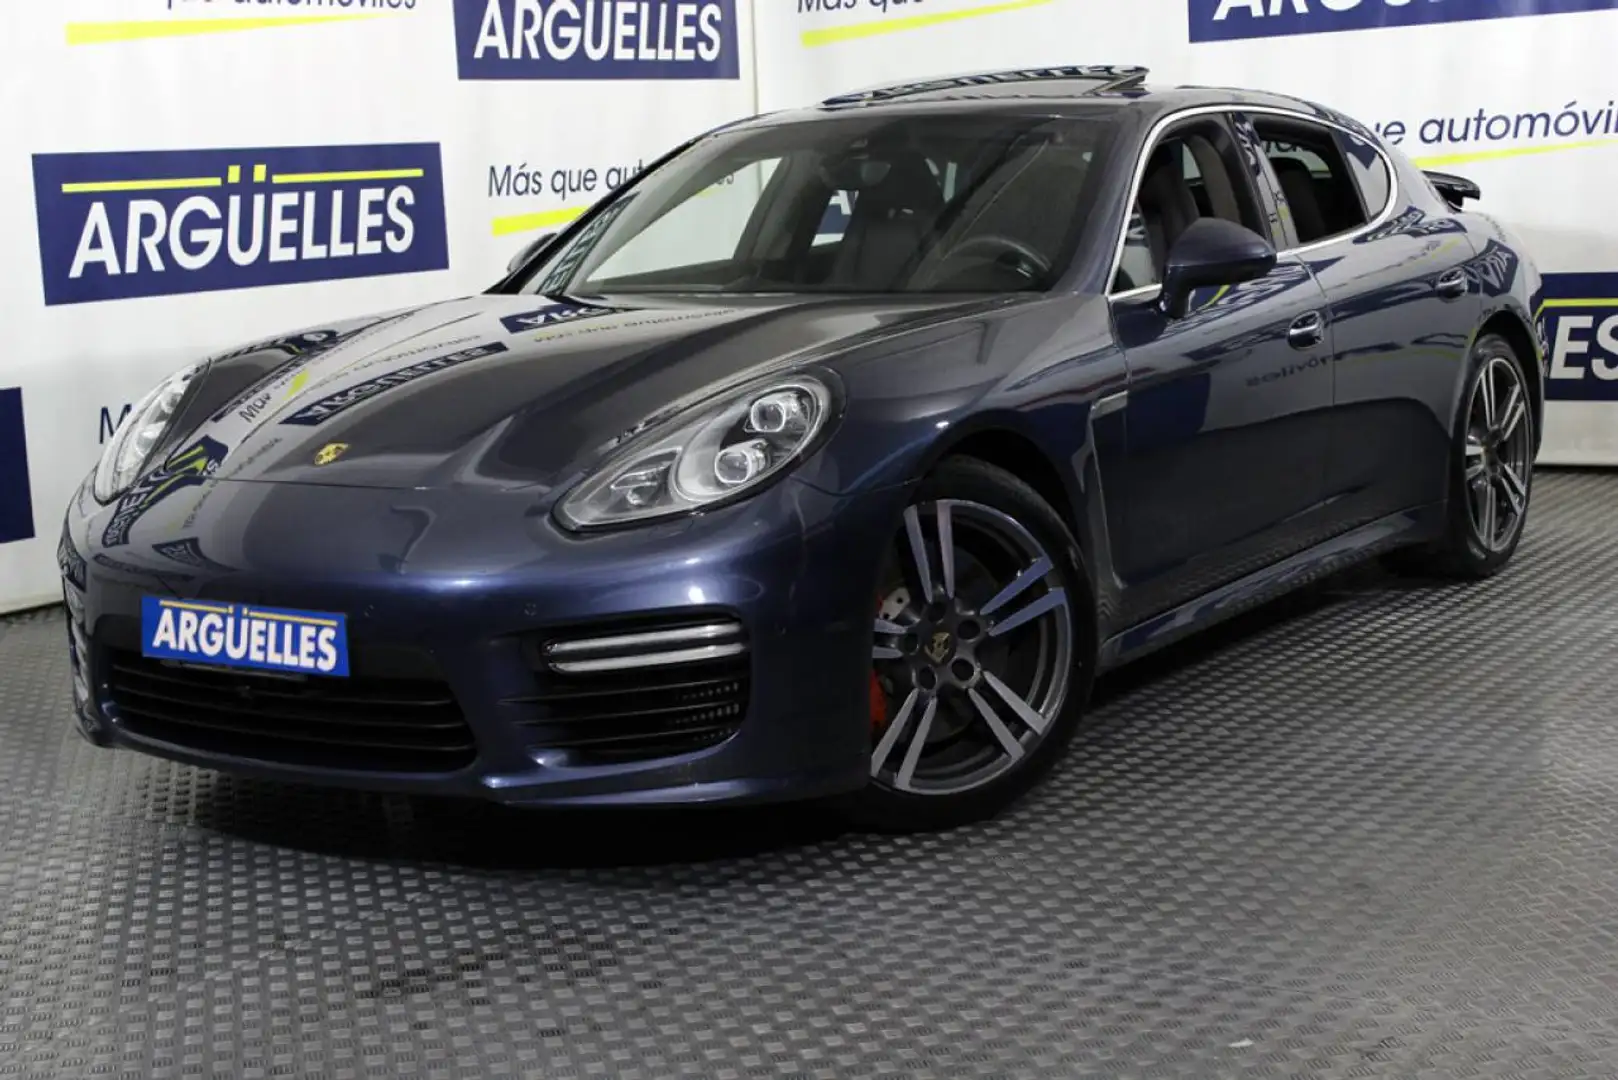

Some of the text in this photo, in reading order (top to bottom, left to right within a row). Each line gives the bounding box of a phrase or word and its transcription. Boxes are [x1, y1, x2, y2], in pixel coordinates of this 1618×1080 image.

[488, 162, 542, 197] Más
[550, 167, 598, 201] que
[68, 164, 416, 278] ARGÜELLES
[152, 605, 338, 672] ARGÜELLES
